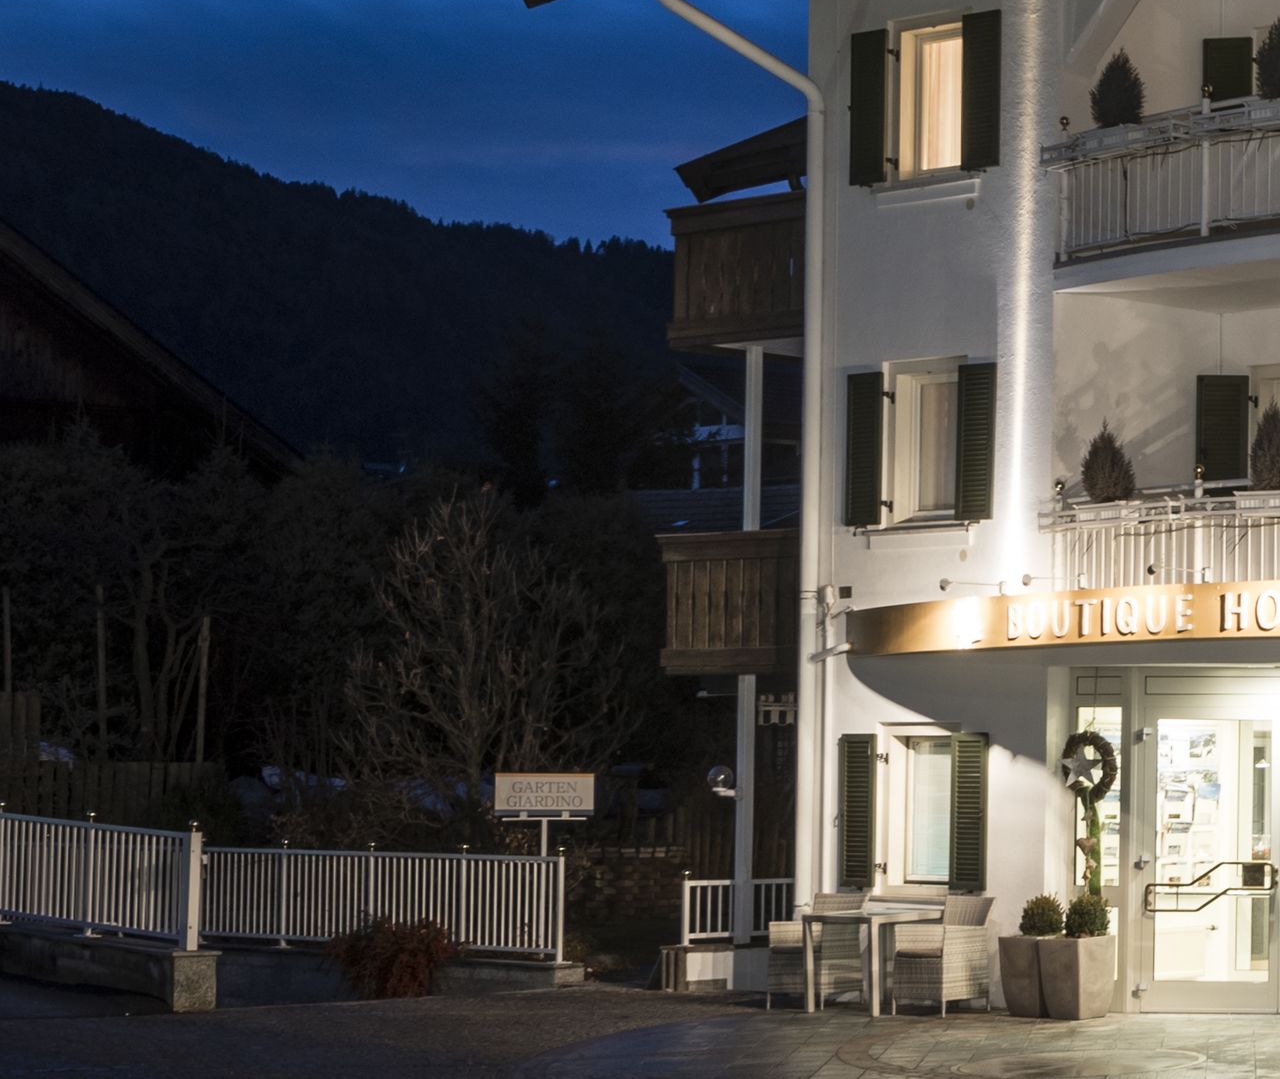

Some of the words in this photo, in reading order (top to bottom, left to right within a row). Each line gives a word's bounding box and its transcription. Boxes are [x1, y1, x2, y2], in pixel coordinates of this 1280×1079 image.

[1006, 593, 1193, 641] BOUTIQUE
[511, 781, 577, 794] GARTEN
[506, 795, 583, 808] GIARDINO
